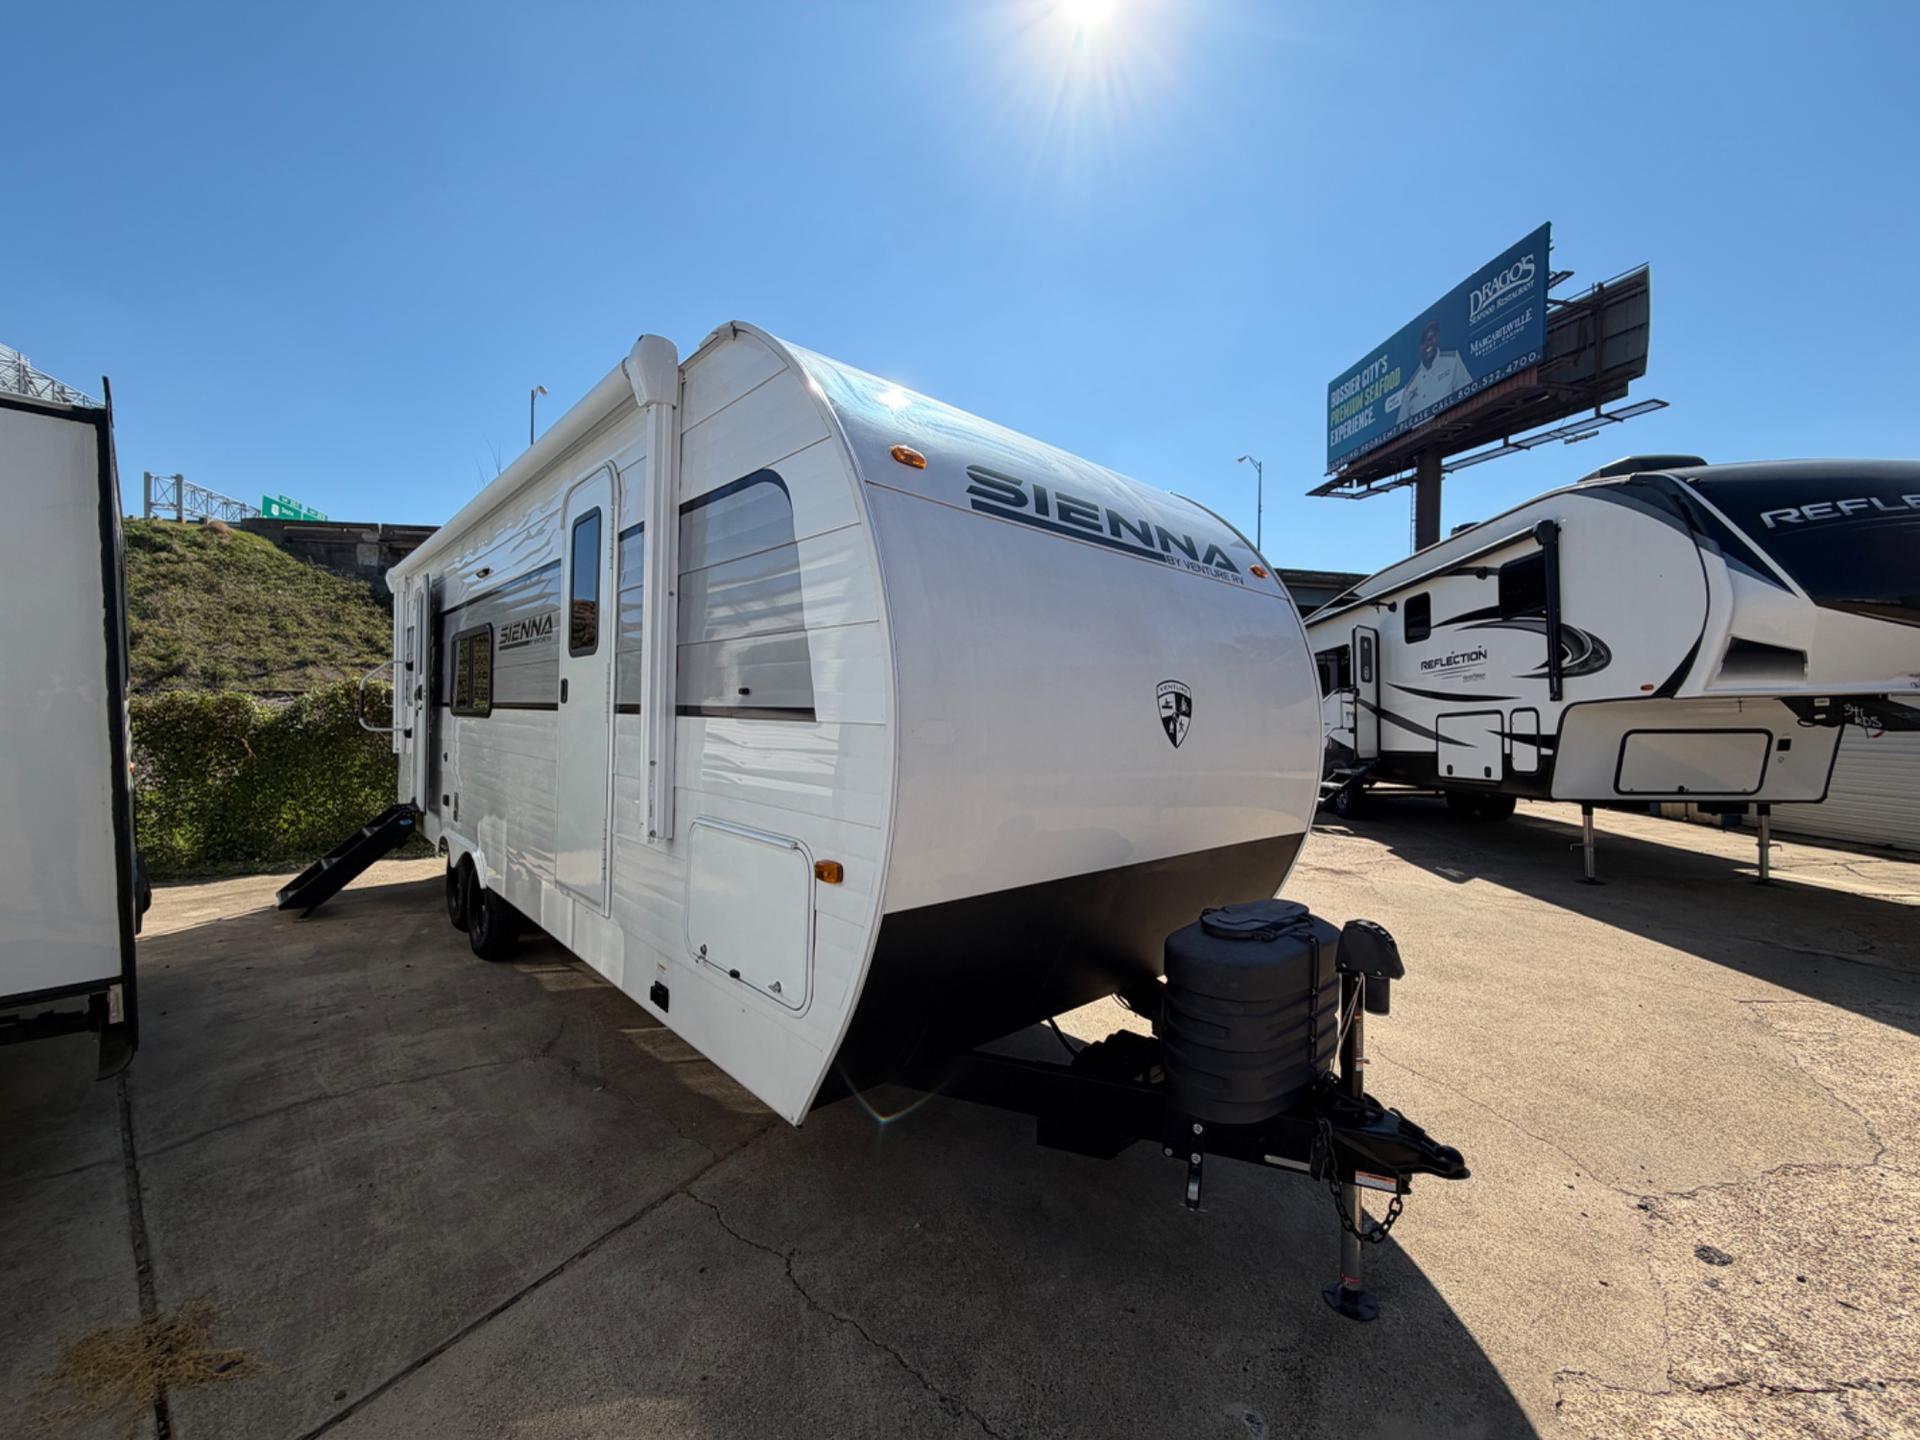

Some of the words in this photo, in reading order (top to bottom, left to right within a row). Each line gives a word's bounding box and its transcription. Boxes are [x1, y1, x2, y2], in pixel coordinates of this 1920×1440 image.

[966, 464, 1241, 574] SIENNA
[1166, 555, 1181, 567] BY
[1183, 559, 1230, 581] VENTURE
[499, 614, 554, 645] SIENNA
[1421, 648, 1488, 671] REFLECTION
